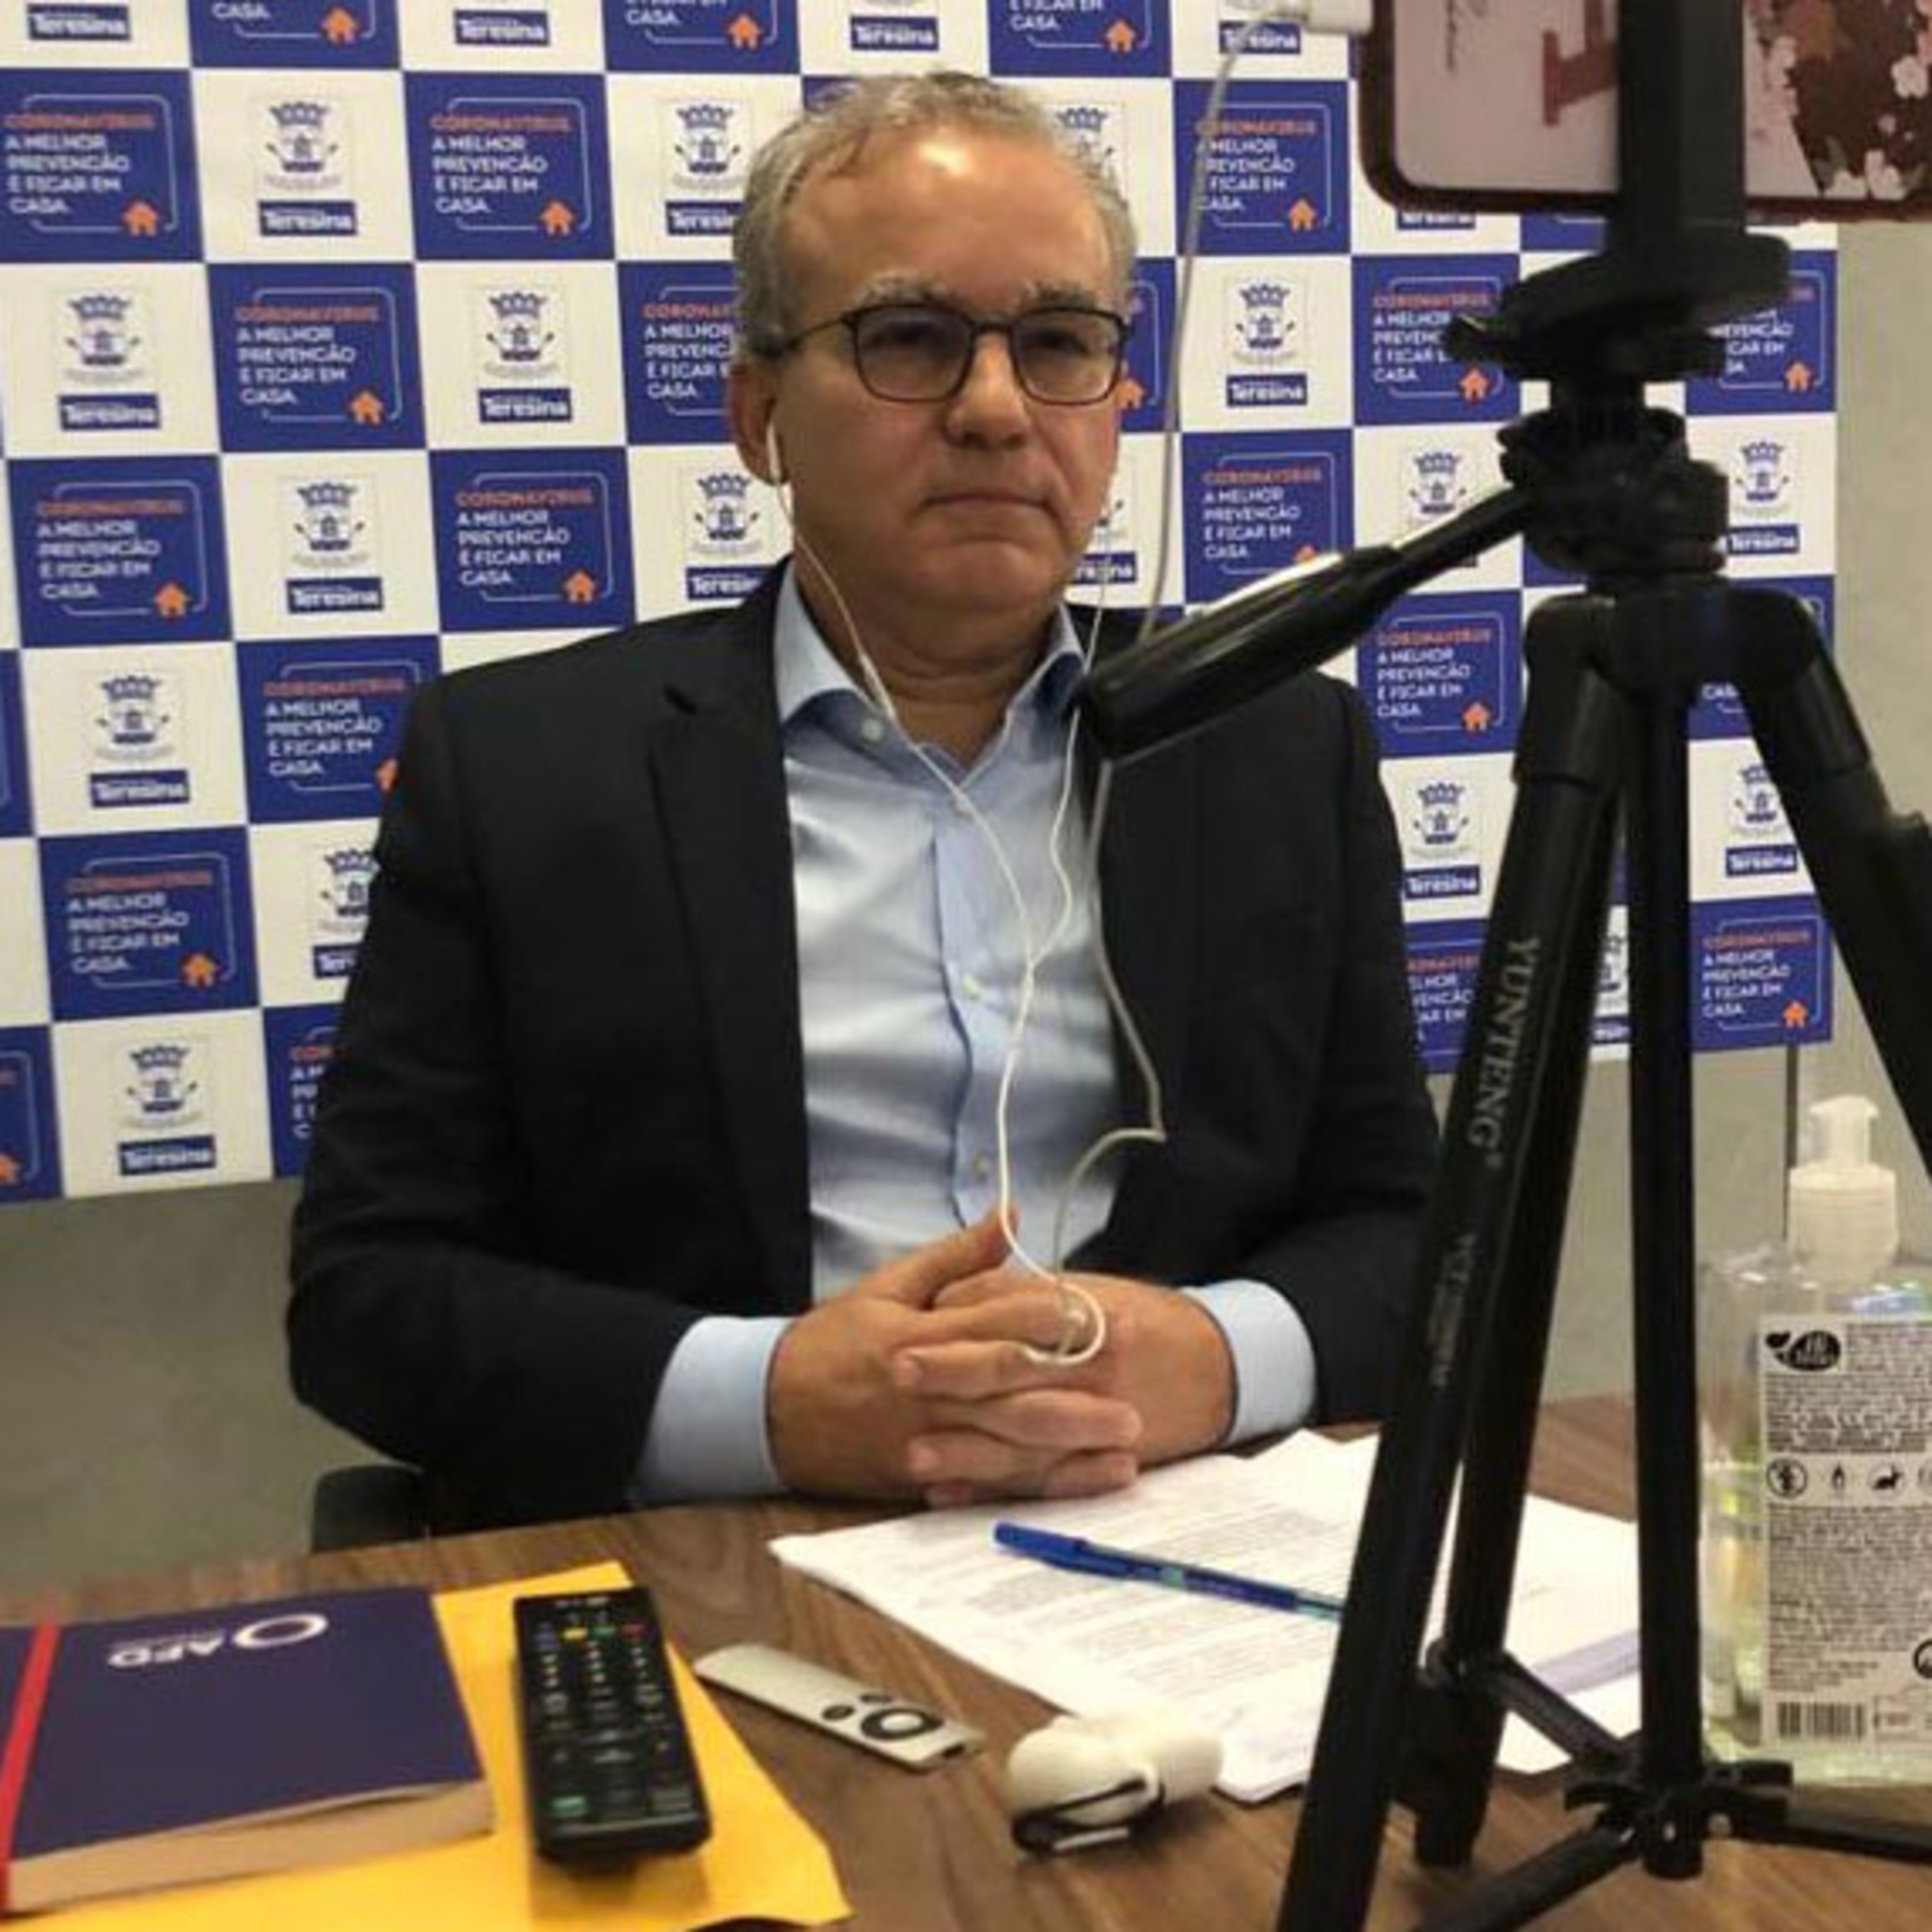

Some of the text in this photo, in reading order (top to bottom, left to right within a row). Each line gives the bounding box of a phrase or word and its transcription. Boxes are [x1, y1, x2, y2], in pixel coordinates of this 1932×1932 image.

[32, 15, 126, 35] Teresina
[460, 20, 545, 40] Teresina
[855, 25, 934, 44] Teresina
[6, 135, 106, 149] A MELHOR
[433, 136, 525, 149] A MELHOR
[1212, 138, 1277, 152] MELHOR
[26, 176, 87, 192] FICAR
[91, 176, 121, 192] EM
[453, 176, 509, 191] FICAR
[512, 176, 538, 191] EM
[1211, 178, 1285, 191] FICAR EM
[264, 210, 353, 231] Teresina
[671, 210, 735, 231] Teresi
[1374, 314, 1385, 326] A
[236, 327, 333, 341] A MELHOR
[644, 325, 657, 338] A
[1764, 341, 1785, 354] EM
[1388, 349, 1435, 363] FICAR
[256, 368, 314, 383] FICAR
[319, 368, 346, 383] EM
[662, 363, 717, 377] FICAR
[1230, 382, 1304, 402] Teresina
[64, 404, 155, 425] Teresina
[484, 398, 568, 419] Teresina
[1205, 488, 1284, 502] A MELHOR
[458, 510, 547, 526] A MELHOR
[38, 521, 136, 537] A MELHOR
[1218, 526, 1265, 539] FICAR
[1269, 525, 1291, 538] EM
[1730, 532, 1795, 549] Teresina
[476, 549, 533, 564] FICAR
[537, 549, 561, 563] EM
[56, 561, 117, 576] FICAR
[122, 560, 150, 574] EM
[292, 587, 379, 607] Teresina
[1378, 649, 1454, 663] A MELHOR
[1391, 685, 1435, 699] FICAR
[1440, 684, 1462, 697] EM
[266, 700, 360, 715] A MELHOR
[284, 740, 342, 755] FICAR
[346, 738, 372, 753] EM
[96, 781, 185, 801] Teresina
[1730, 855, 1794, 872] Teresina
[1408, 873, 1476, 892] Teresina
[69, 893, 166, 911] A MELHOR
[86, 934, 147, 950] FICAR
[151, 933, 180, 947] EM
[1703, 951, 1774, 965] A MELHOR
[1716, 984, 1758, 998] FICAR
[1761, 983, 1781, 994] EM
[1445, 1008, 1466, 1021] EM
[291, 1068, 302, 1079] A
[124, 1144, 213, 1169] Teresina
